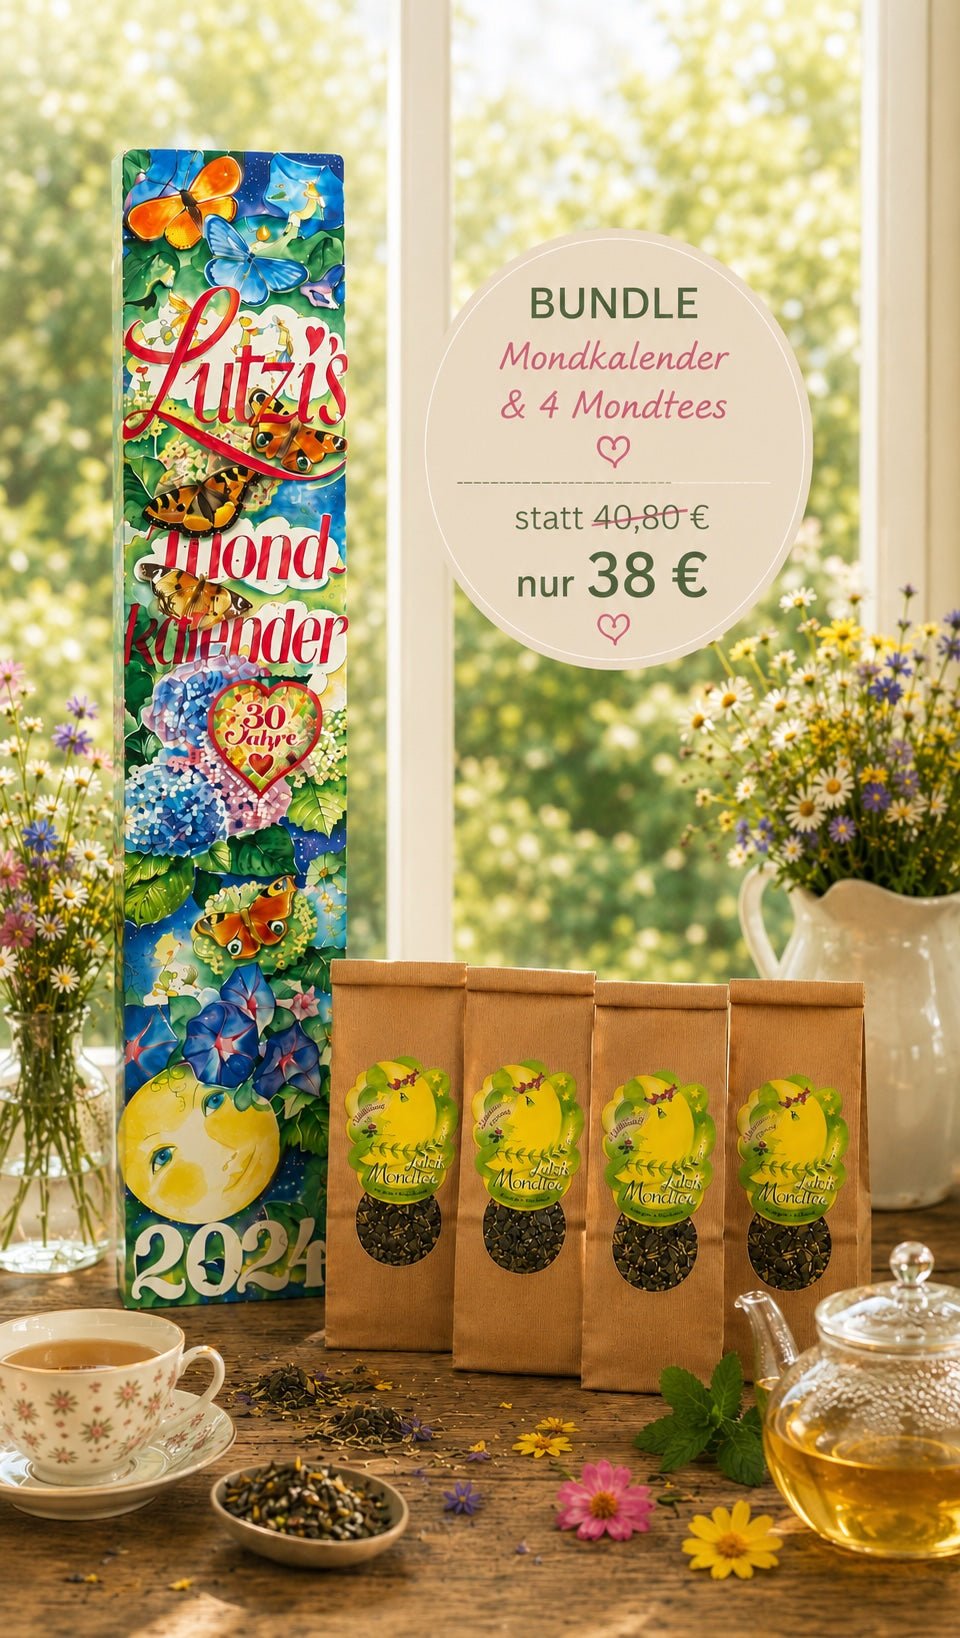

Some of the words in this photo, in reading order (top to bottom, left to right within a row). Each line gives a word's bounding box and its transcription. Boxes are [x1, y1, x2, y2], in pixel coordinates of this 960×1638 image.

[243, 703, 286, 729] 30
[225, 725, 298, 751] Jahre
[131, 1217, 326, 1300] 2024
